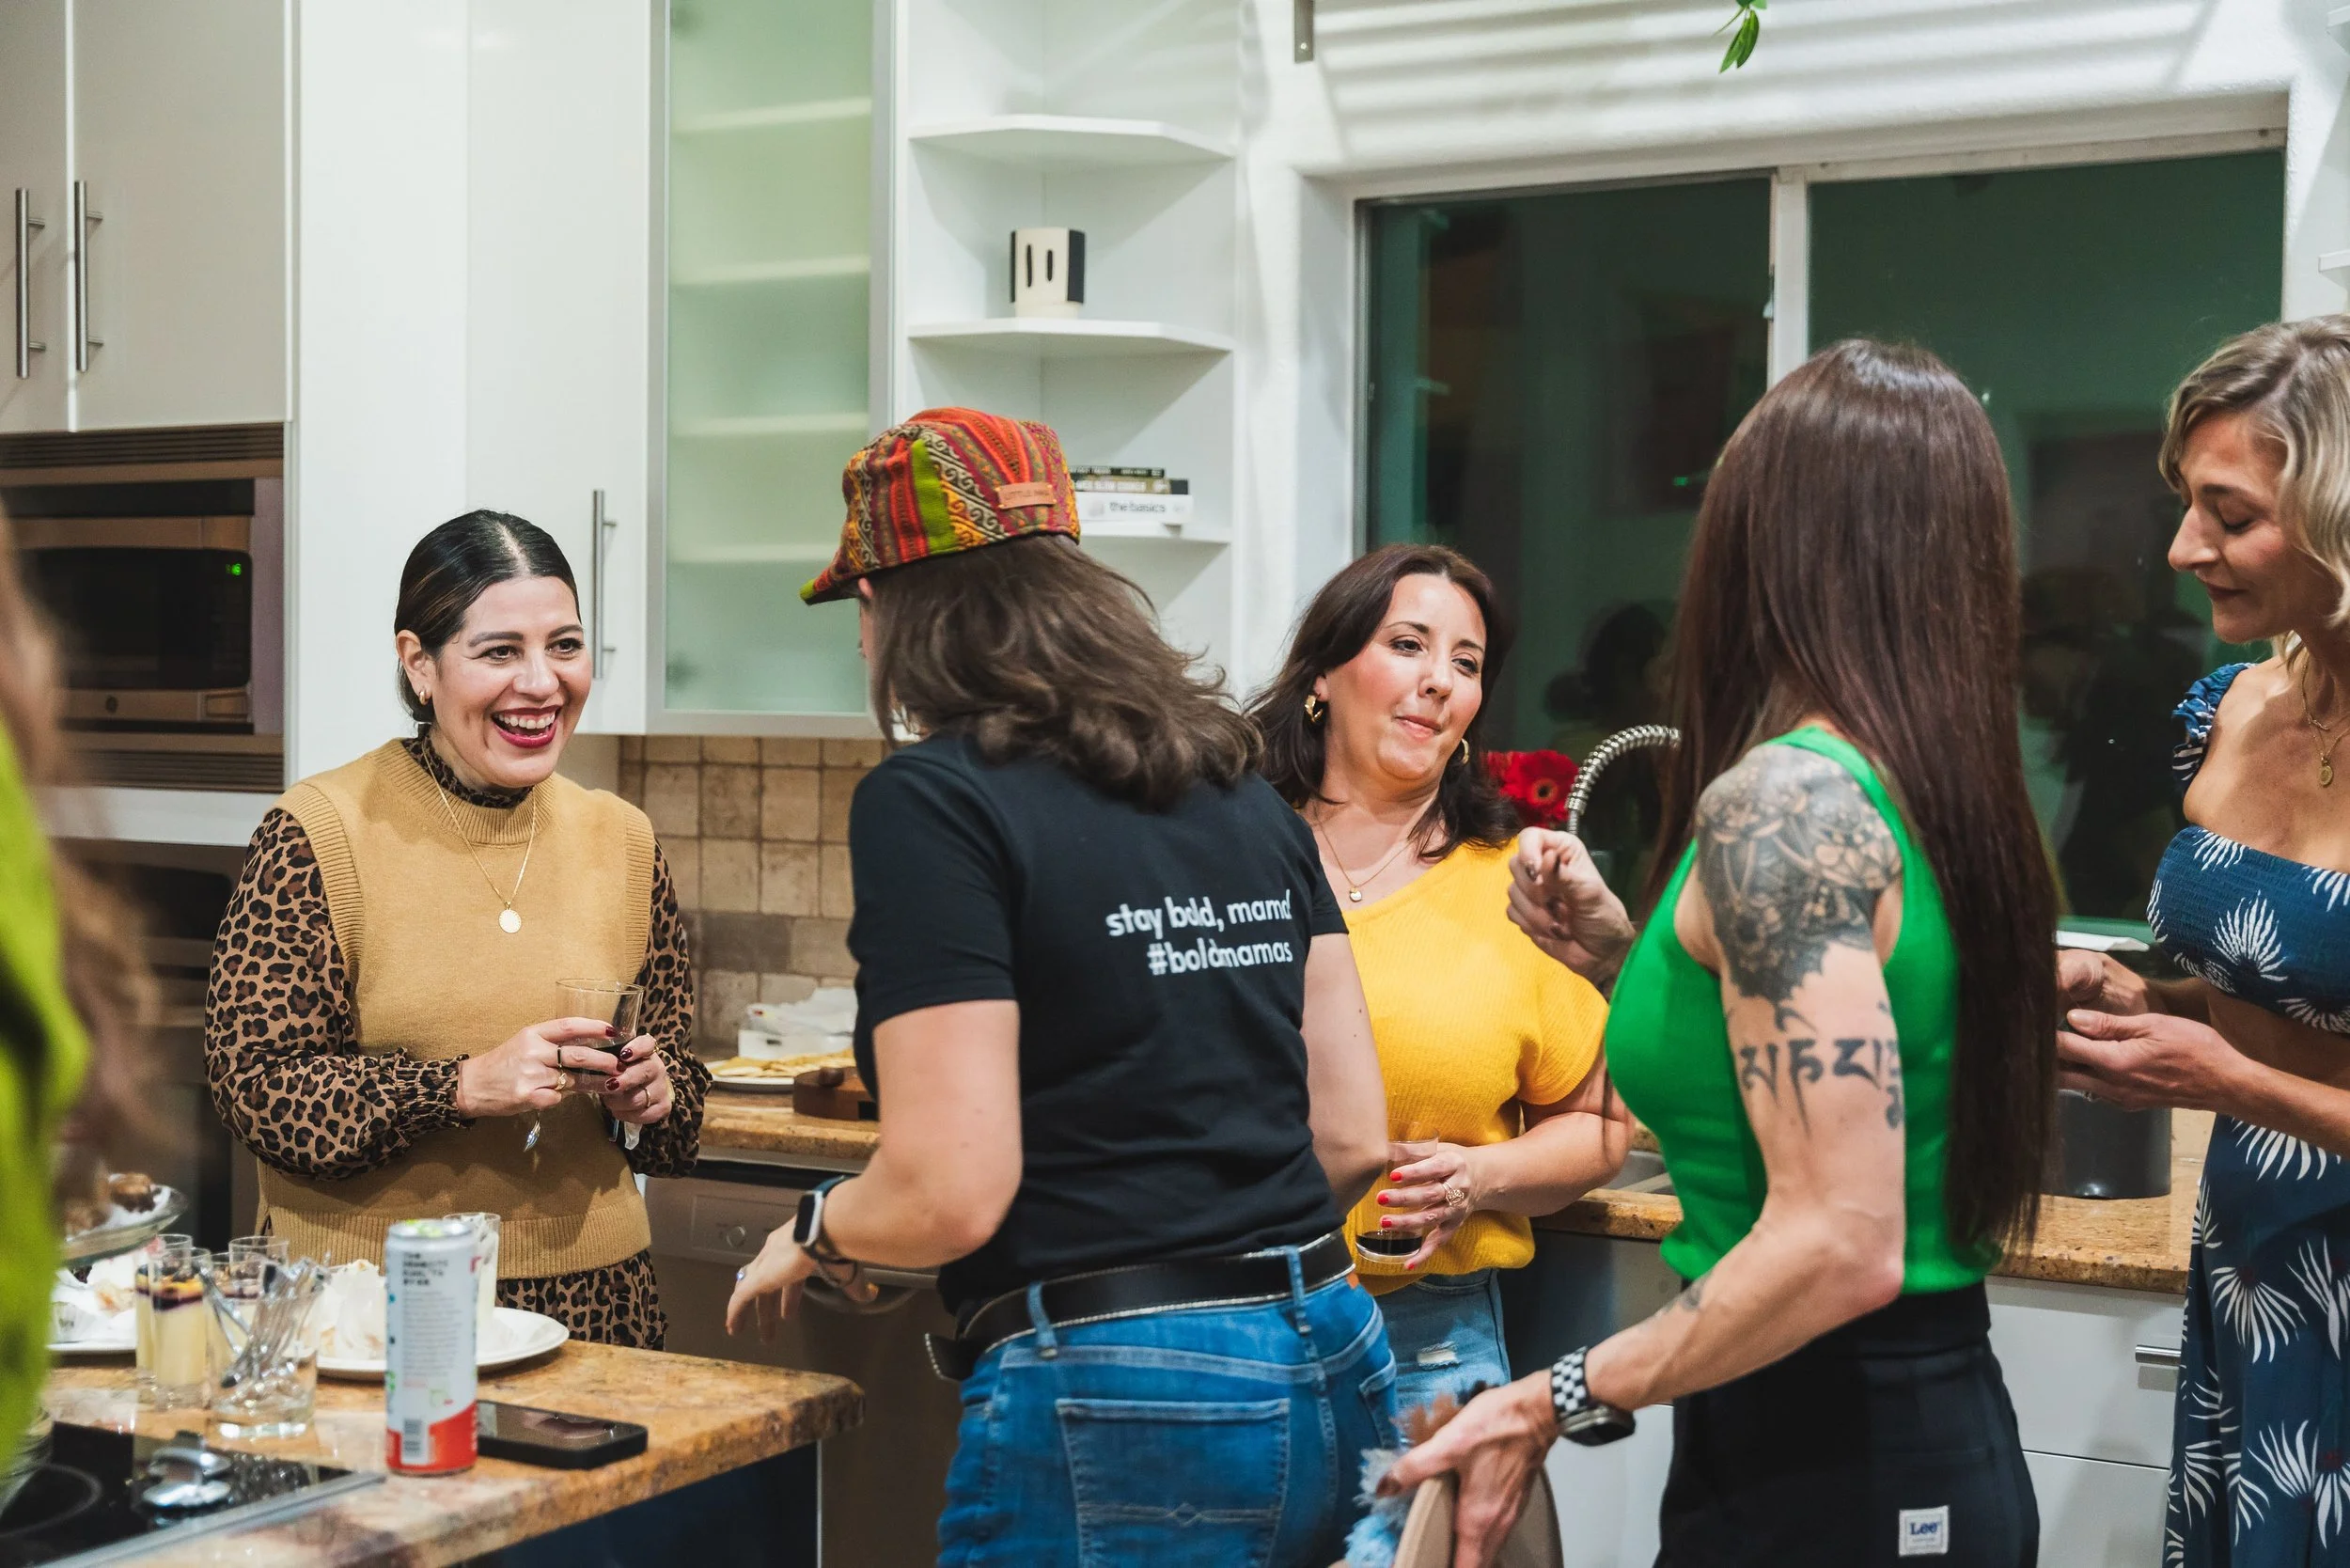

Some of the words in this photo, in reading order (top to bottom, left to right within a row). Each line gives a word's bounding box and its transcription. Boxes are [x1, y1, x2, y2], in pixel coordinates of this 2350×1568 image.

[1109, 501, 1128, 512] the
[1129, 501, 1167, 512] basics
[1105, 903, 1164, 940] stay
[1146, 937, 1294, 977] #boldmamas
[1909, 1522, 1938, 1536] Lee
